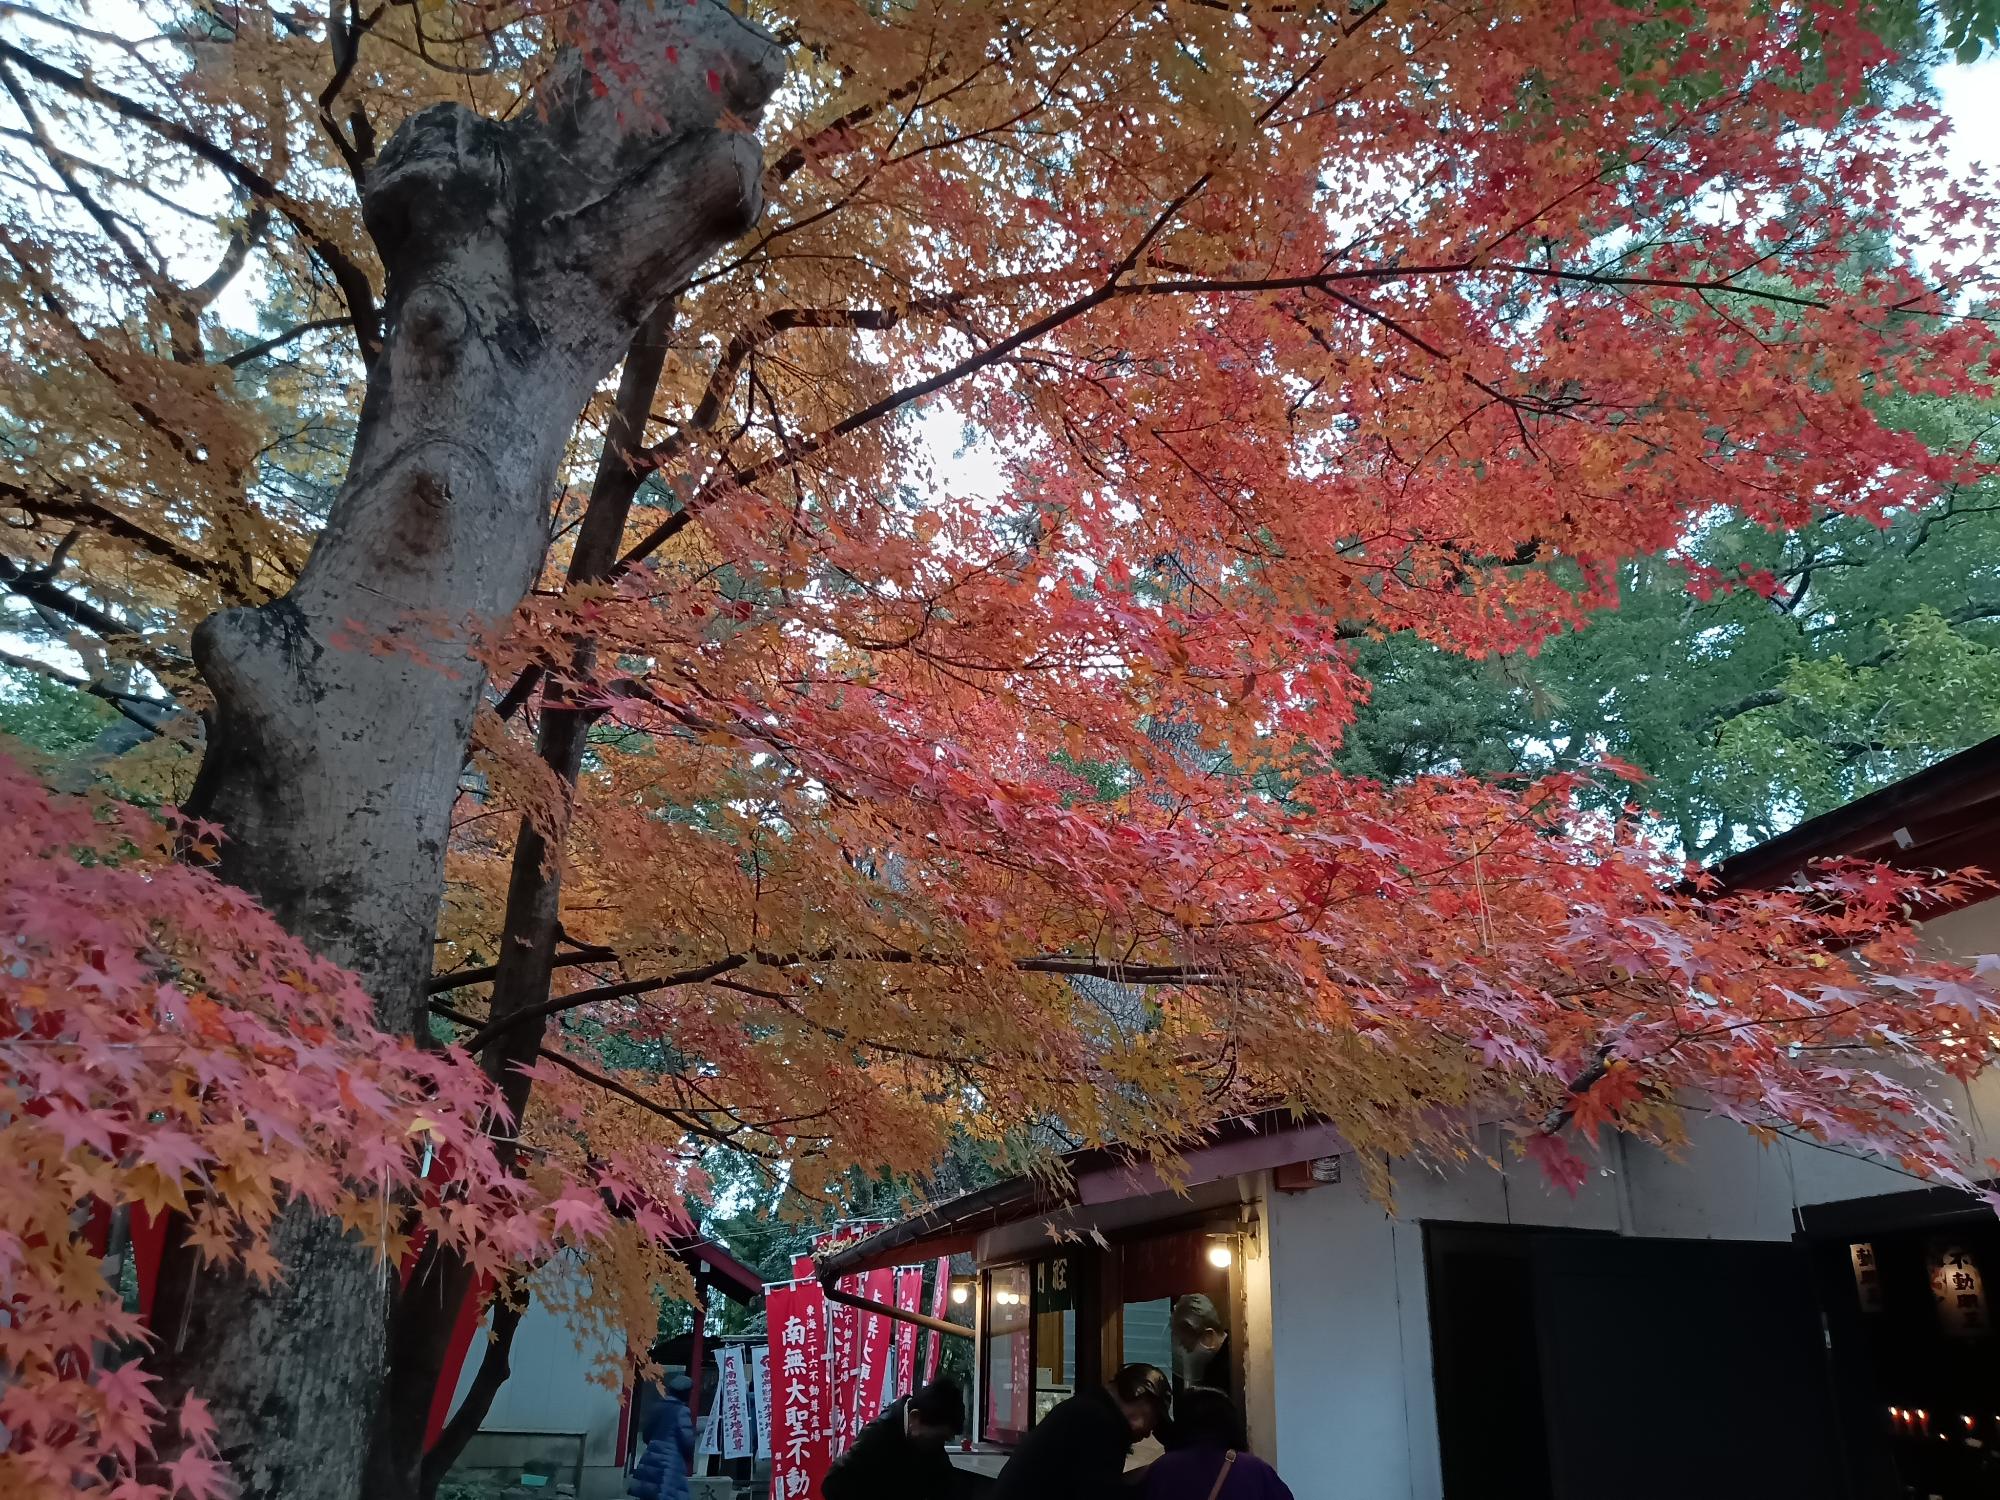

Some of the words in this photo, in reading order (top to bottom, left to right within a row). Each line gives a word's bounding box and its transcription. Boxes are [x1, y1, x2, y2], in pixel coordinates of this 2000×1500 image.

[782, 1315, 811, 1500] 南無大聖不動
